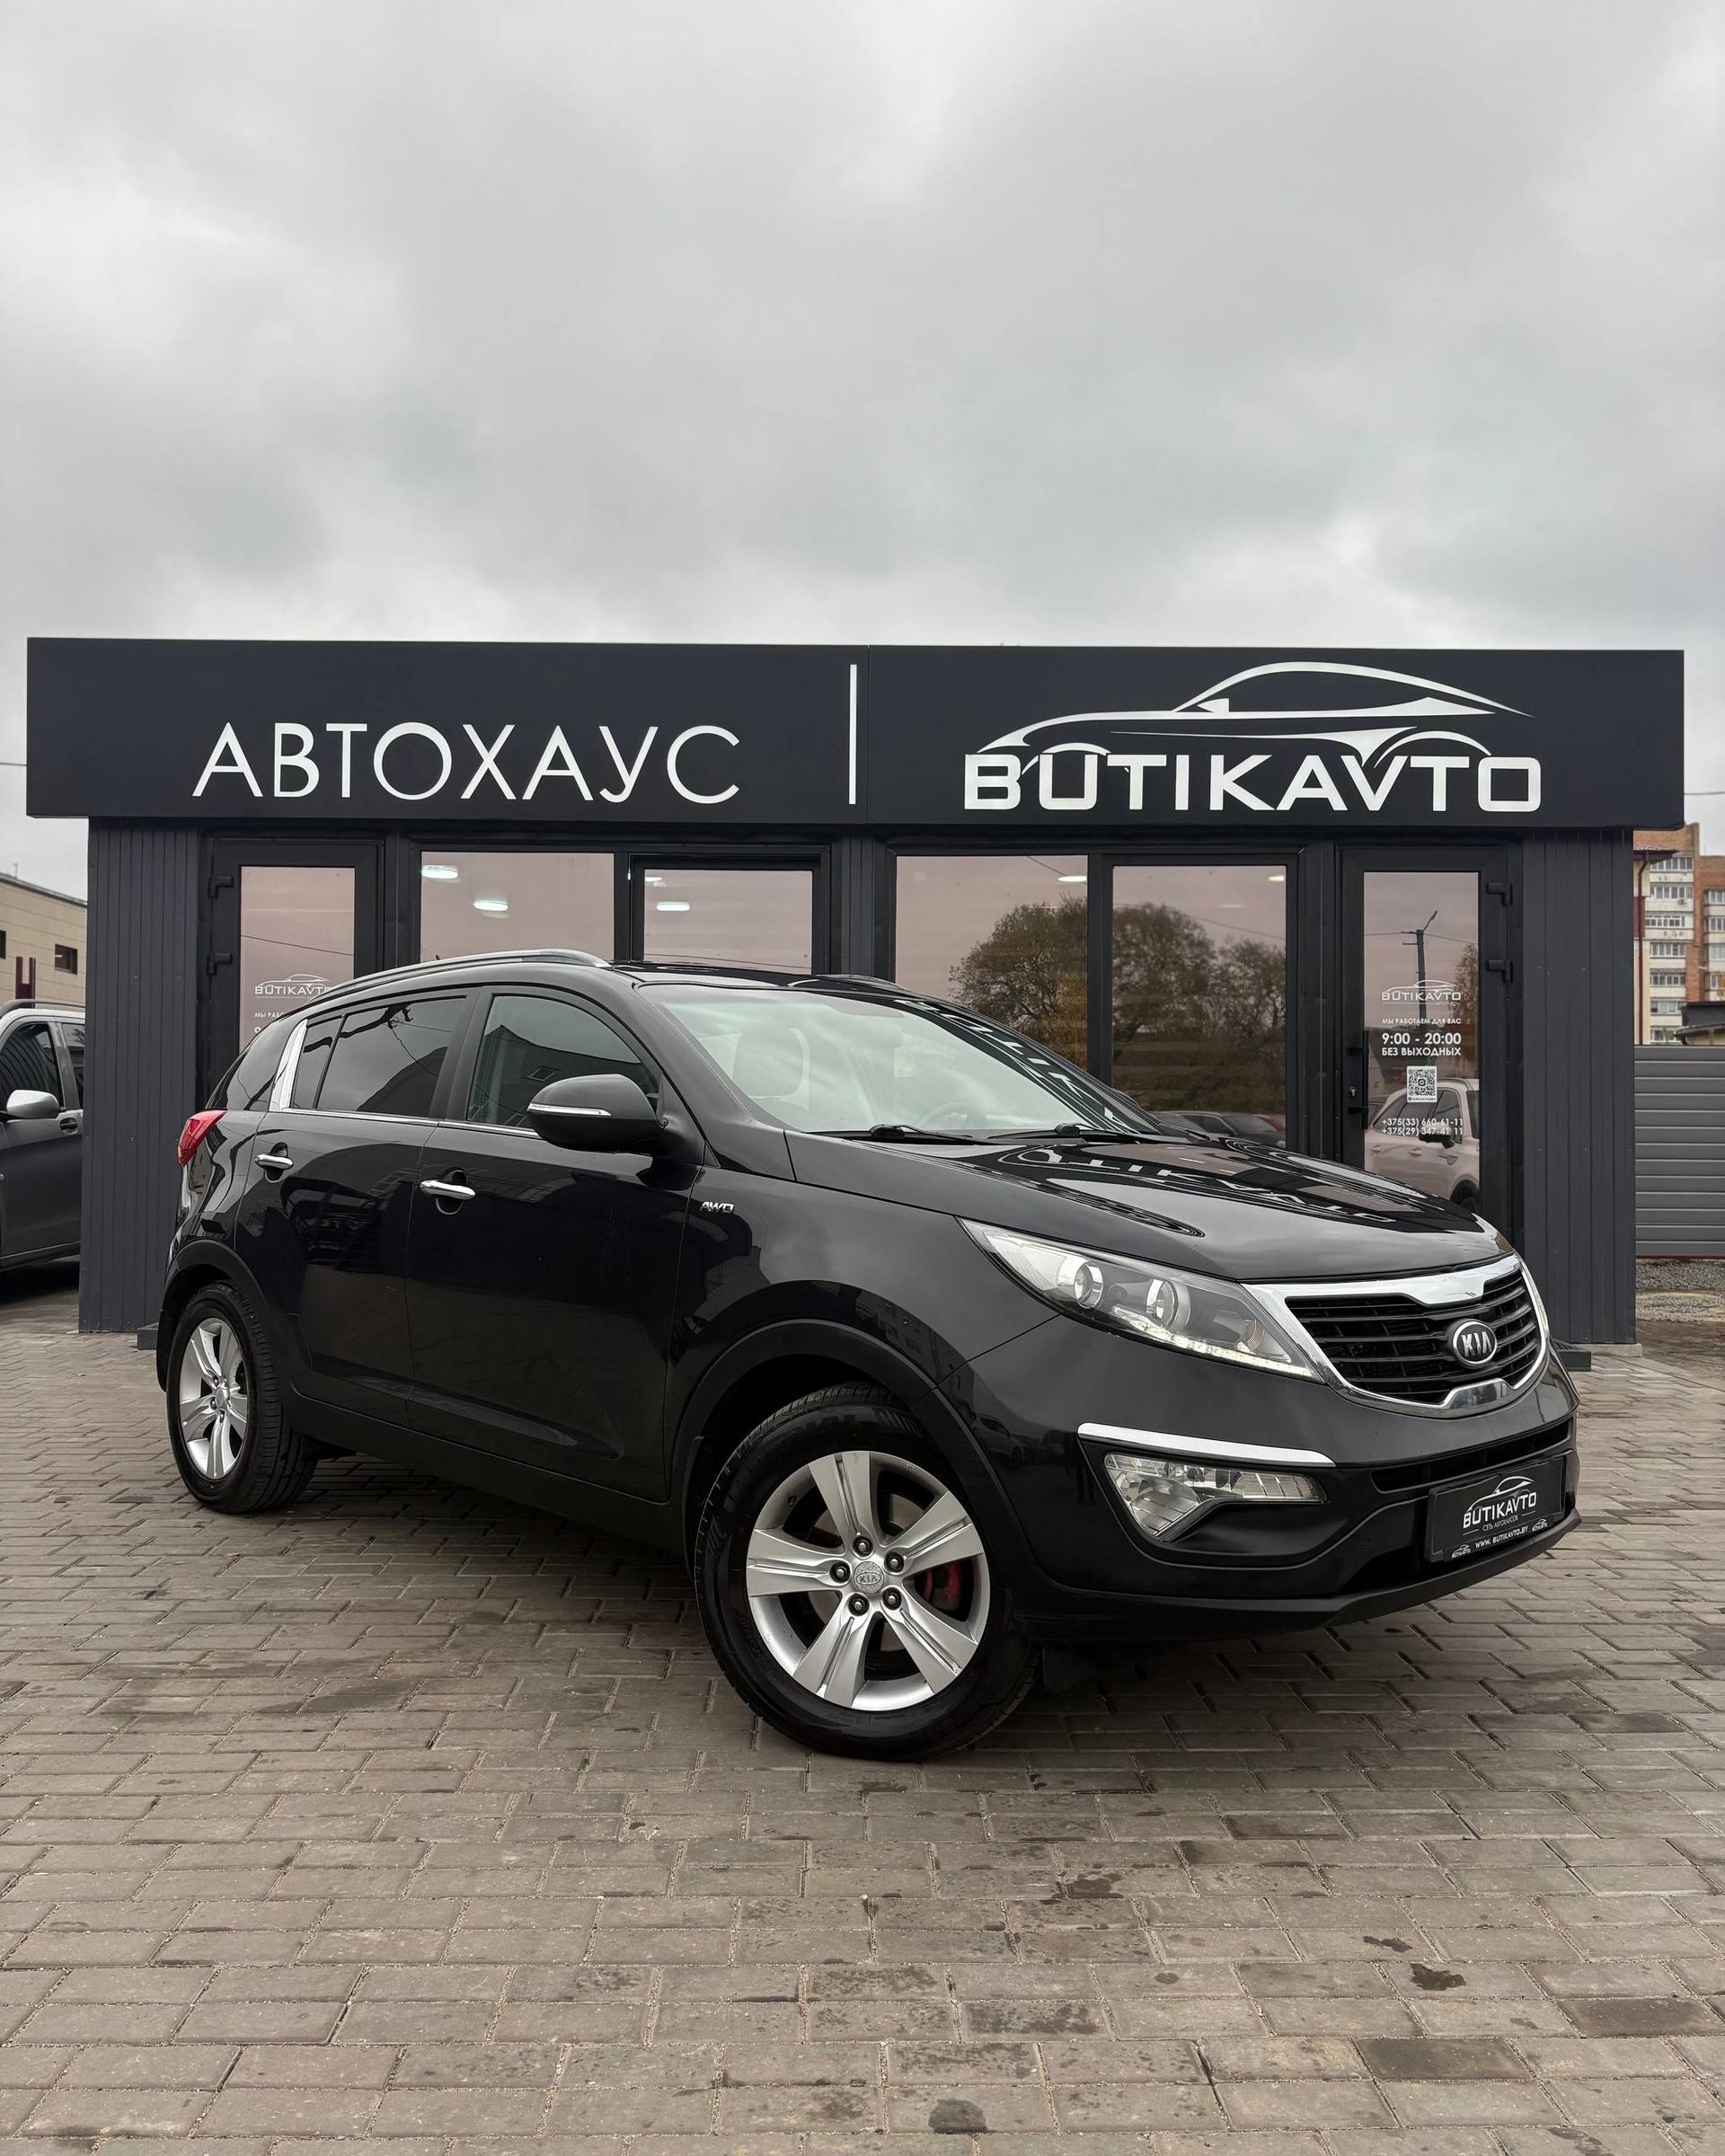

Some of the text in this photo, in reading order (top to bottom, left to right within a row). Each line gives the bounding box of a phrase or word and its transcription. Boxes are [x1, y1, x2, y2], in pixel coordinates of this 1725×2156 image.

[193, 722, 739, 803] АВТОХАУС
[965, 754, 1541, 811] BUTIKAVTO
[1381, 992, 1462, 1001] BUTIKAVTO
[1382, 1032, 1411, 1045] 9:00
[1424, 1032, 1462, 1045] 20:00
[1382, 1047, 1462, 1056] БЕЗ ВЫХОДНЫХ
[1382, 1118, 1463, 1127] +375(33) 660-61-11
[1382, 1127, 1463, 1136] +375(29) 347-4111
[700, 1201, 735, 1213] AWD
[1461, 1331, 1492, 1357] KIA
[1463, 1491, 1537, 1529] BUTIKAVTO
[1492, 1525, 1528, 1543] BUTIKAVTO.BY
[860, 1575, 878, 1583] KIA
